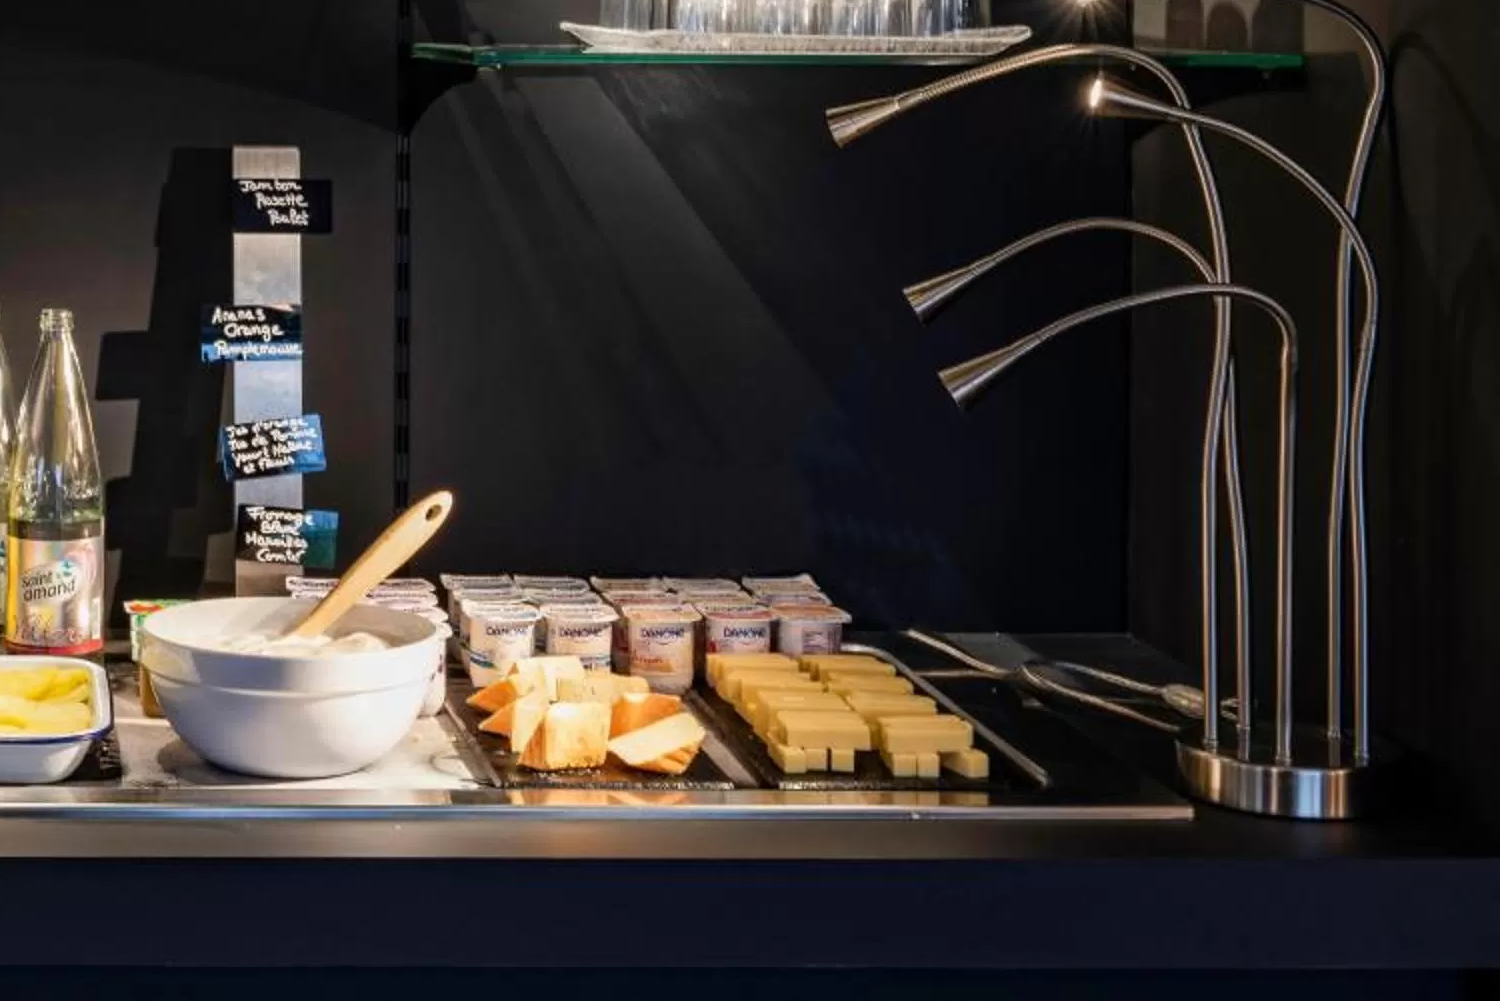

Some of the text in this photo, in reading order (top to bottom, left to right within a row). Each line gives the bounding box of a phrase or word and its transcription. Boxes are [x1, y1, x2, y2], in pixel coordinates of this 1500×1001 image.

[238, 178, 302, 193] Jambon
[255, 191, 309, 210] Rosette
[266, 207, 309, 227] Poulet
[211, 305, 267, 325] Ananas
[224, 322, 285, 343] Orange
[641, 628, 685, 638] DANONE
[723, 627, 766, 638] DANONE
